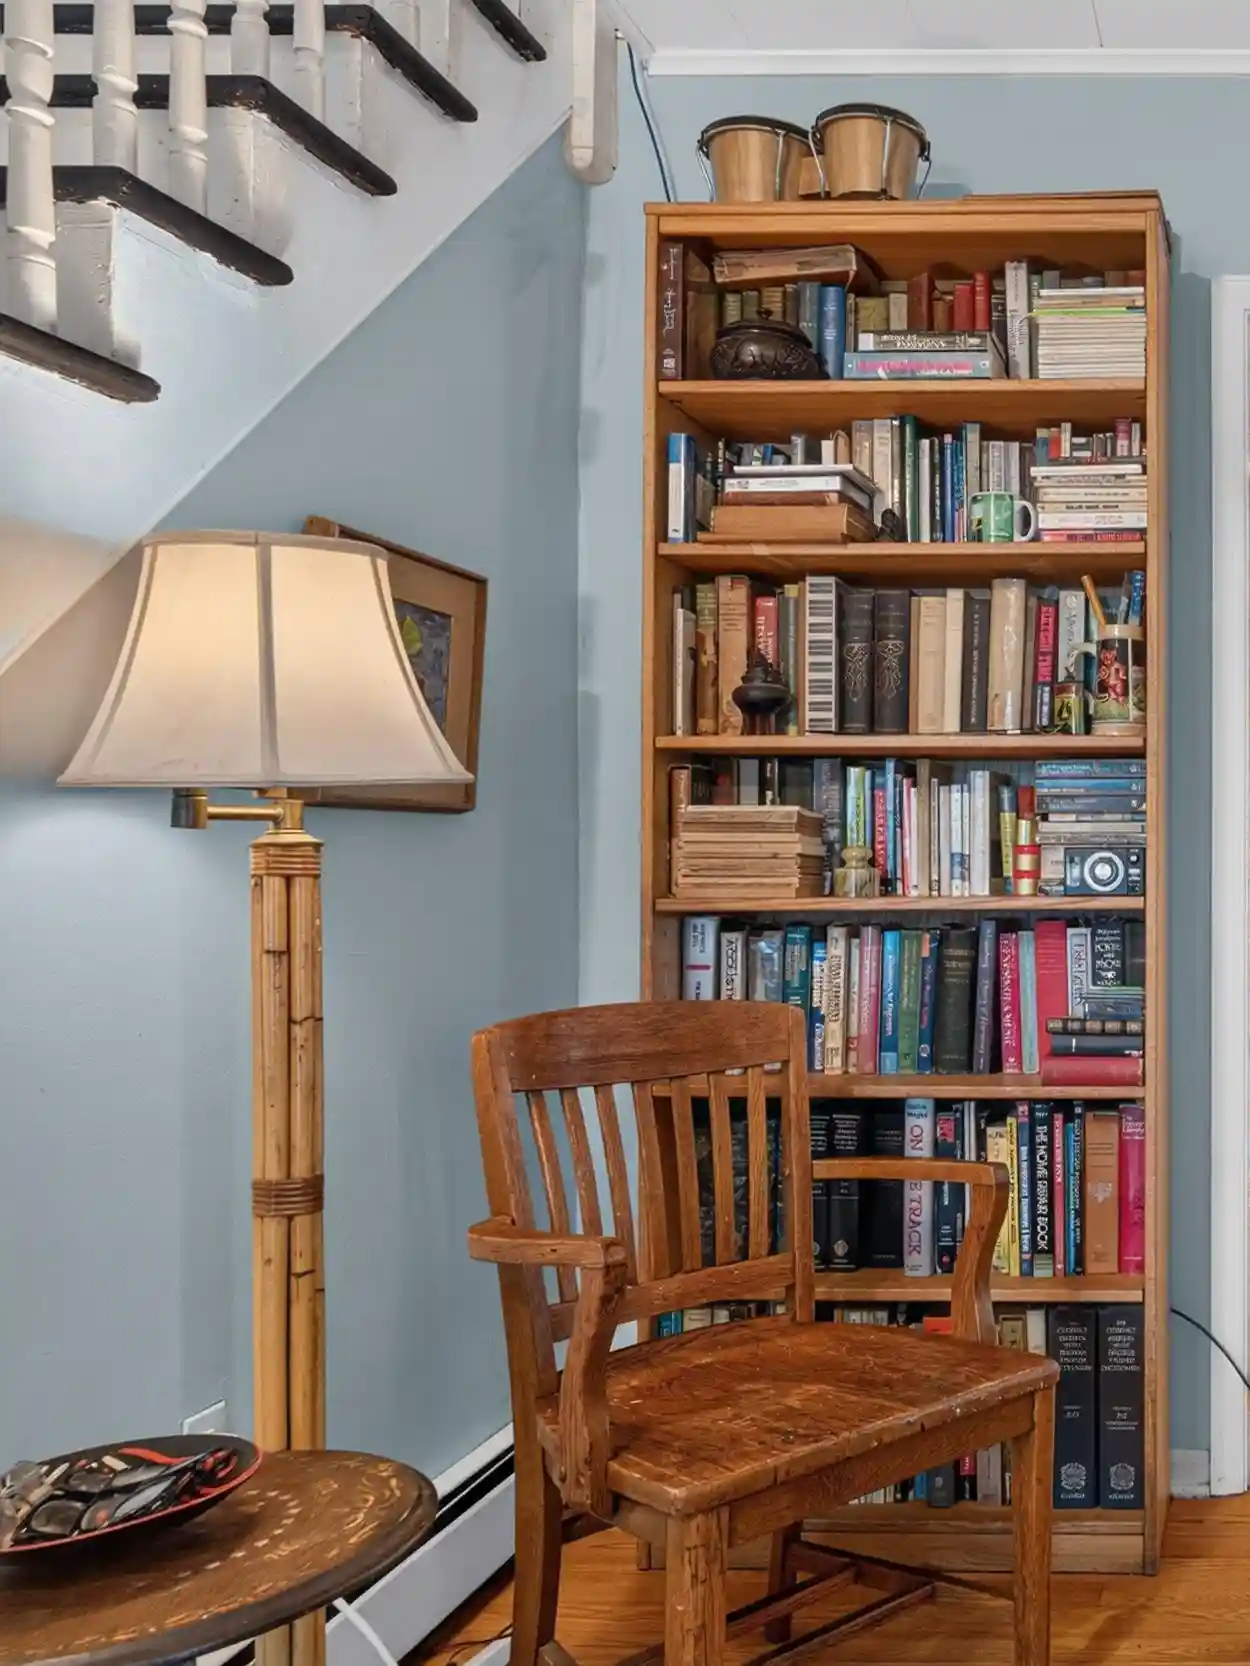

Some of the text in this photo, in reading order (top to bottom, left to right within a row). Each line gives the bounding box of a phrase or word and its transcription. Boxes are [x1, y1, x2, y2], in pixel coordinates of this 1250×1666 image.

[910, 1124, 924, 1151] ON
[1035, 1125, 1048, 1144] THE
[1035, 1145, 1048, 1178] HOME
[908, 1198, 923, 1256] TRACK
[1036, 1216, 1048, 1250] BOOK
